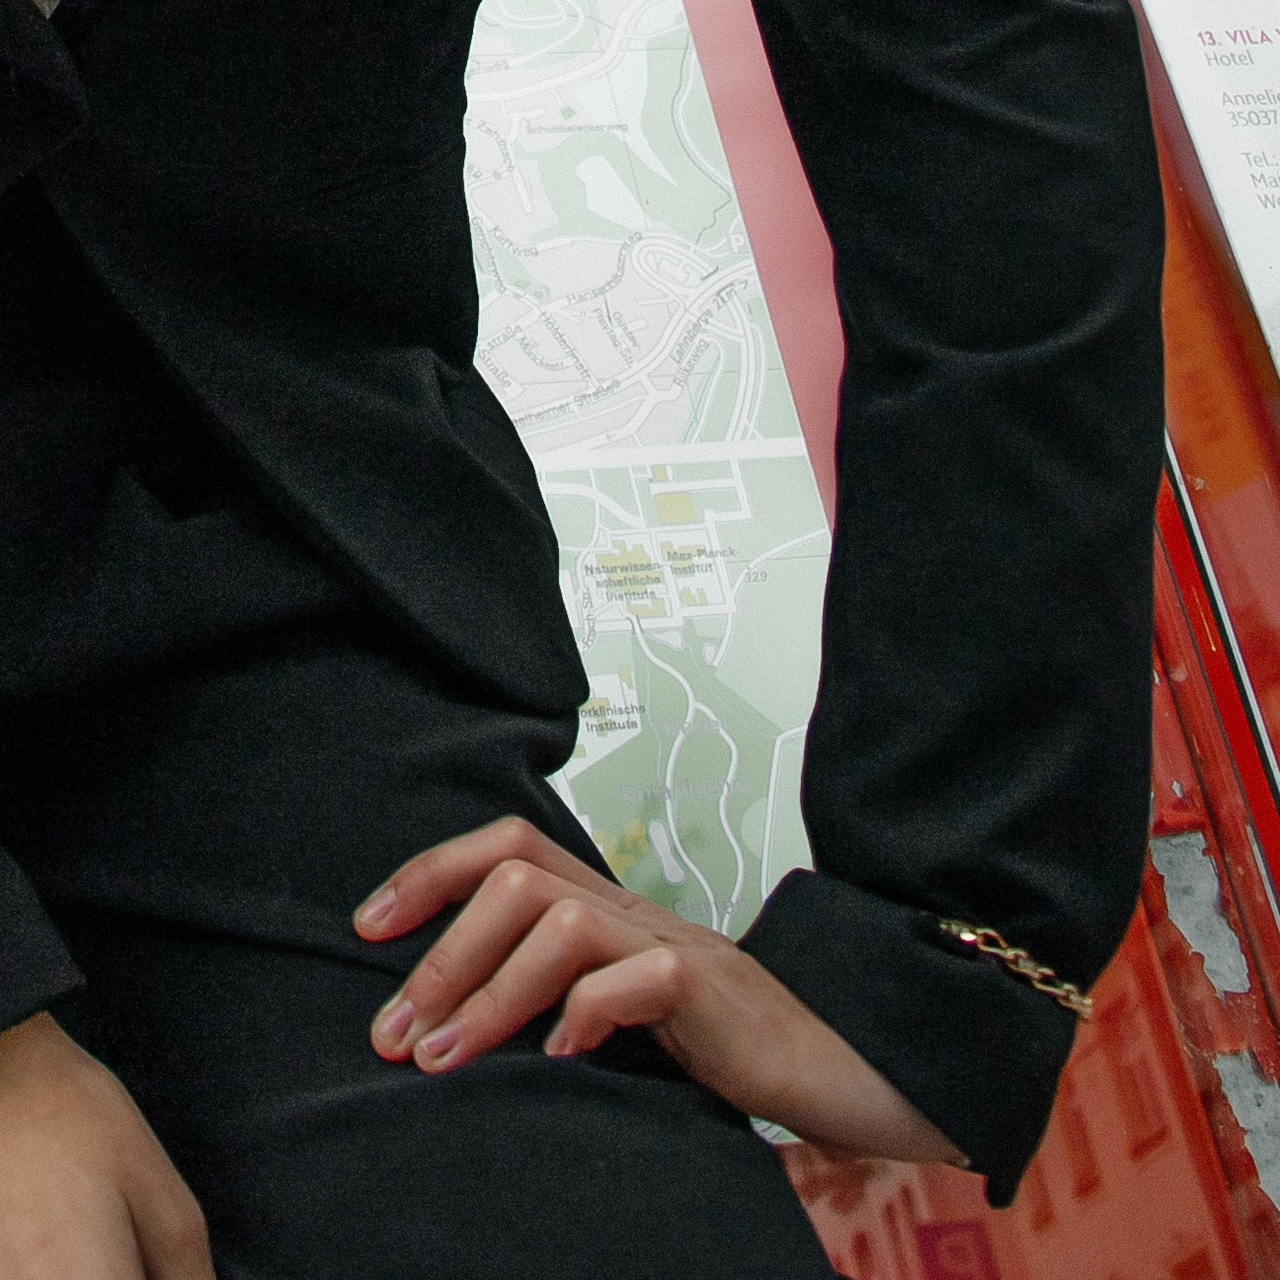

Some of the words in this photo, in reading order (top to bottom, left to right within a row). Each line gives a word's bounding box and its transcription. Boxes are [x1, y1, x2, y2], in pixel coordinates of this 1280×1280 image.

[1197, 30, 1222, 47] 13.
[1225, 28, 1273, 46] VILA
[1205, 49, 1255, 67] Hotel
[1226, 109, 1278, 128] 35037
[578, 702, 646, 719] orklinische
